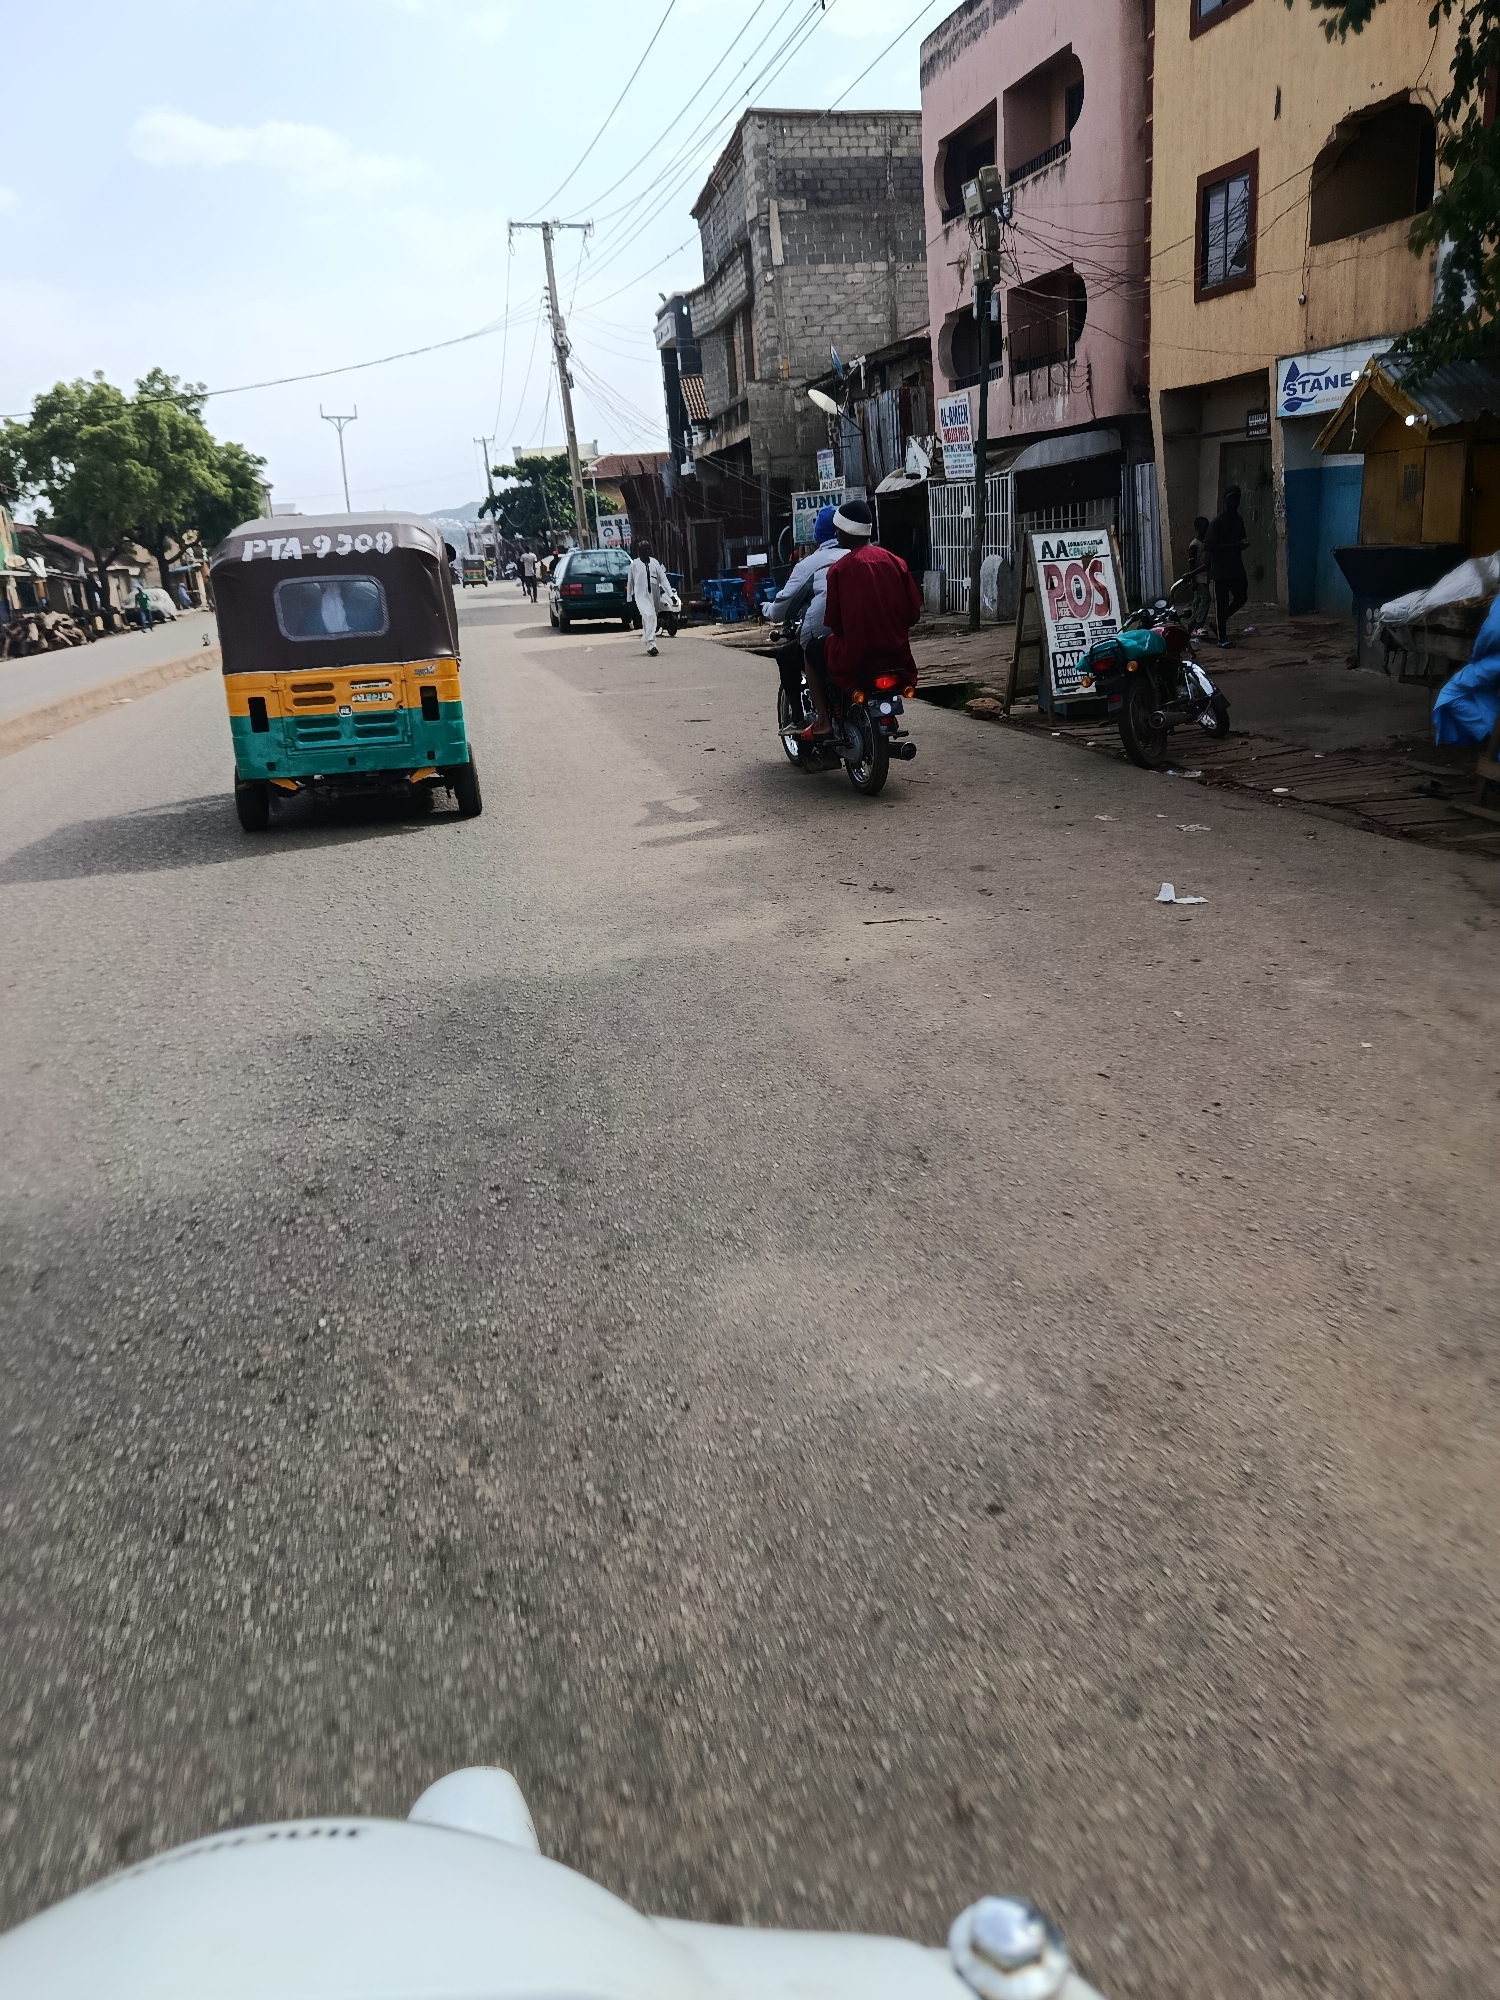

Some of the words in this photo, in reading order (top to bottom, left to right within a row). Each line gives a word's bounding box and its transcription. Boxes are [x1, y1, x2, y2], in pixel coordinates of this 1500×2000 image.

[1286, 372, 1357, 397] STANE
[796, 493, 843, 511] BUNU
[241, 531, 394, 562] PTA-9308
[1041, 539, 1070, 559] AA
[1043, 560, 1111, 620] POS
[1058, 675, 1089, 685] AVAILAB
